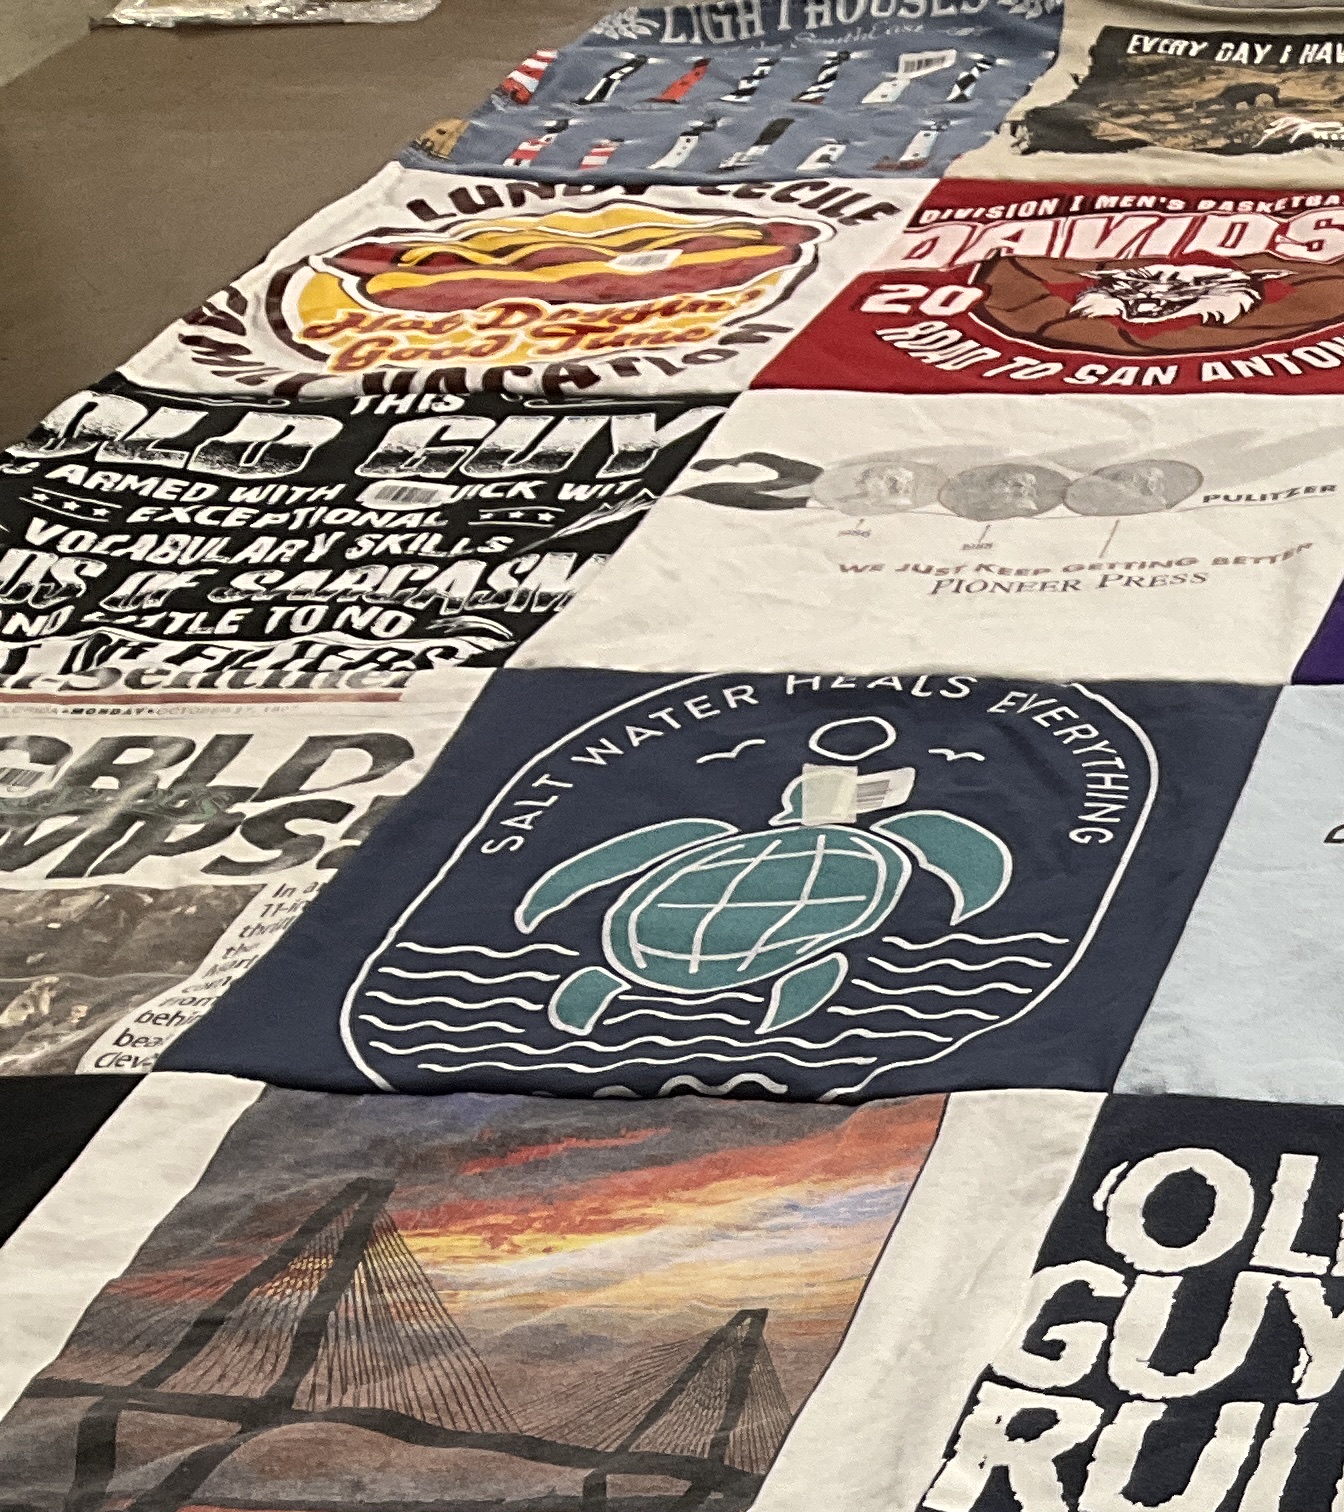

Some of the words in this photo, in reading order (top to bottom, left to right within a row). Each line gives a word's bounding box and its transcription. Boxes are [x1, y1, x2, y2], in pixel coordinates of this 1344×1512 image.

[1127, 34, 1207, 57] EVERY
[1215, 42, 1271, 65] DAY
[921, 195, 1062, 223] DIVISION
[1094, 194, 1185, 210] MEN'S
[860, 284, 983, 316] 20
[330, 335, 513, 373] Good
[875, 322, 988, 370] ROAD
[984, 355, 1056, 382] TO
[1064, 362, 1178, 388] SAN
[350, 392, 466, 415] THIS
[4, 389, 343, 478] OLD
[354, 405, 732, 481] GUY
[45, 463, 220, 503] ARMED
[227, 482, 348, 506] WITH
[1203, 484, 1338, 504] PULITZER
[126, 503, 450, 531] EXCEPTIONAL
[25, 516, 347, 566] VOCABULARY
[345, 530, 515, 559] SKILLS
[838, 562, 885, 574] WE
[900, 561, 967, 577] JUST
[973, 562, 1051, 577] KEEP
[1062, 557, 1200, 574] GETTING
[1211, 542, 1314, 567] BETTER
[929, 578, 1082, 597] PIONEER
[1098, 570, 1209, 591] PRESS
[264, 605, 329, 635] TO
[332, 606, 416, 638] NO
[481, 765, 578, 857] SALT
[570, 683, 760, 766] WATER
[785, 672, 979, 702] HEALS
[985, 689, 1130, 847] EVERYTHING
